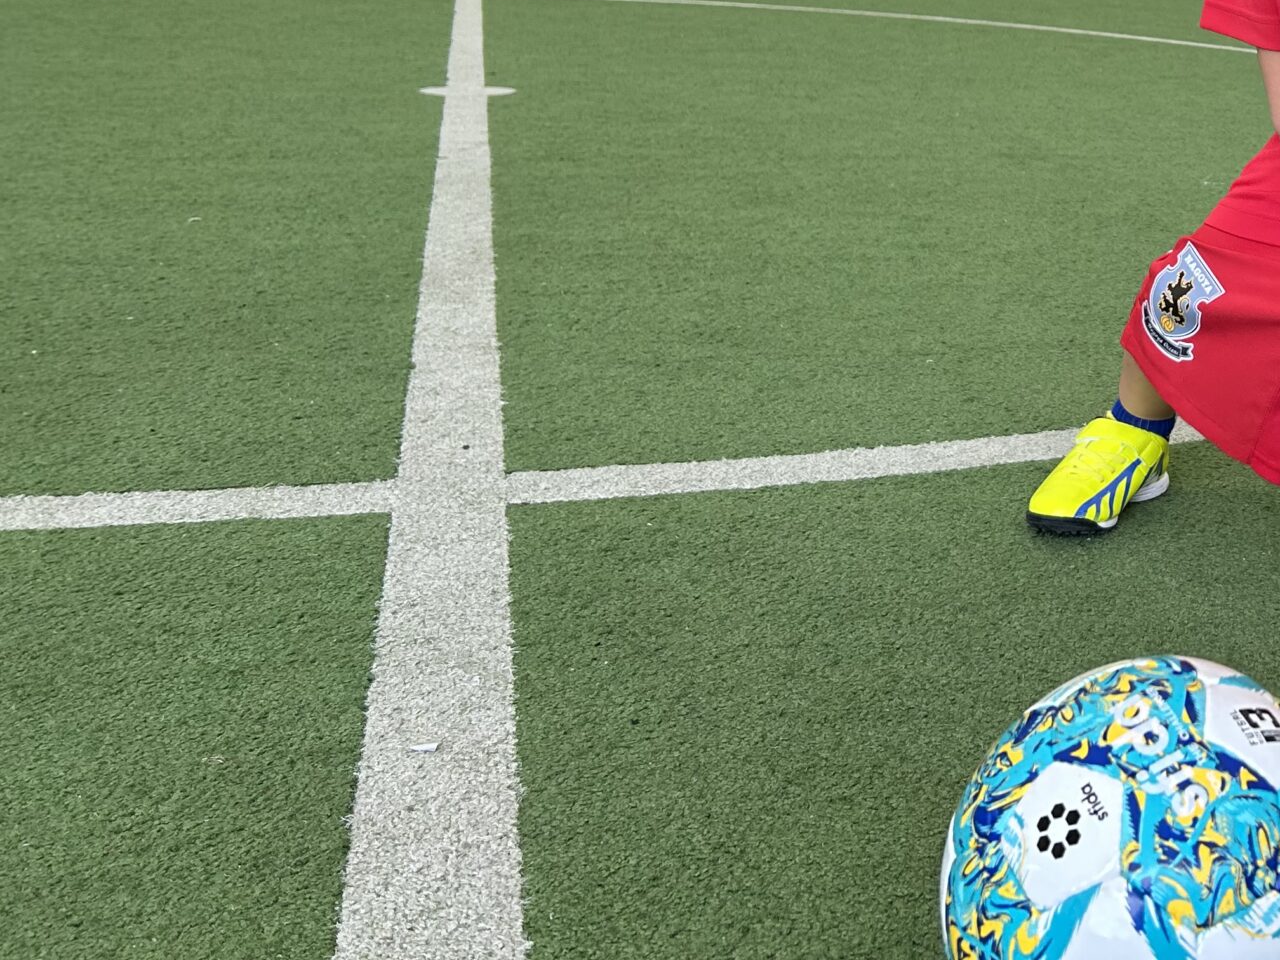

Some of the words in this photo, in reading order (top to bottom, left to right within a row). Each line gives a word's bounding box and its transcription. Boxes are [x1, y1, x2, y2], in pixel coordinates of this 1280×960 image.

[1184, 253, 1213, 295] NAGOYA
[1230, 709, 1258, 746] FUTSAL
[1110, 694, 1209, 817] sfida
[1081, 782, 1109, 821] sfida
